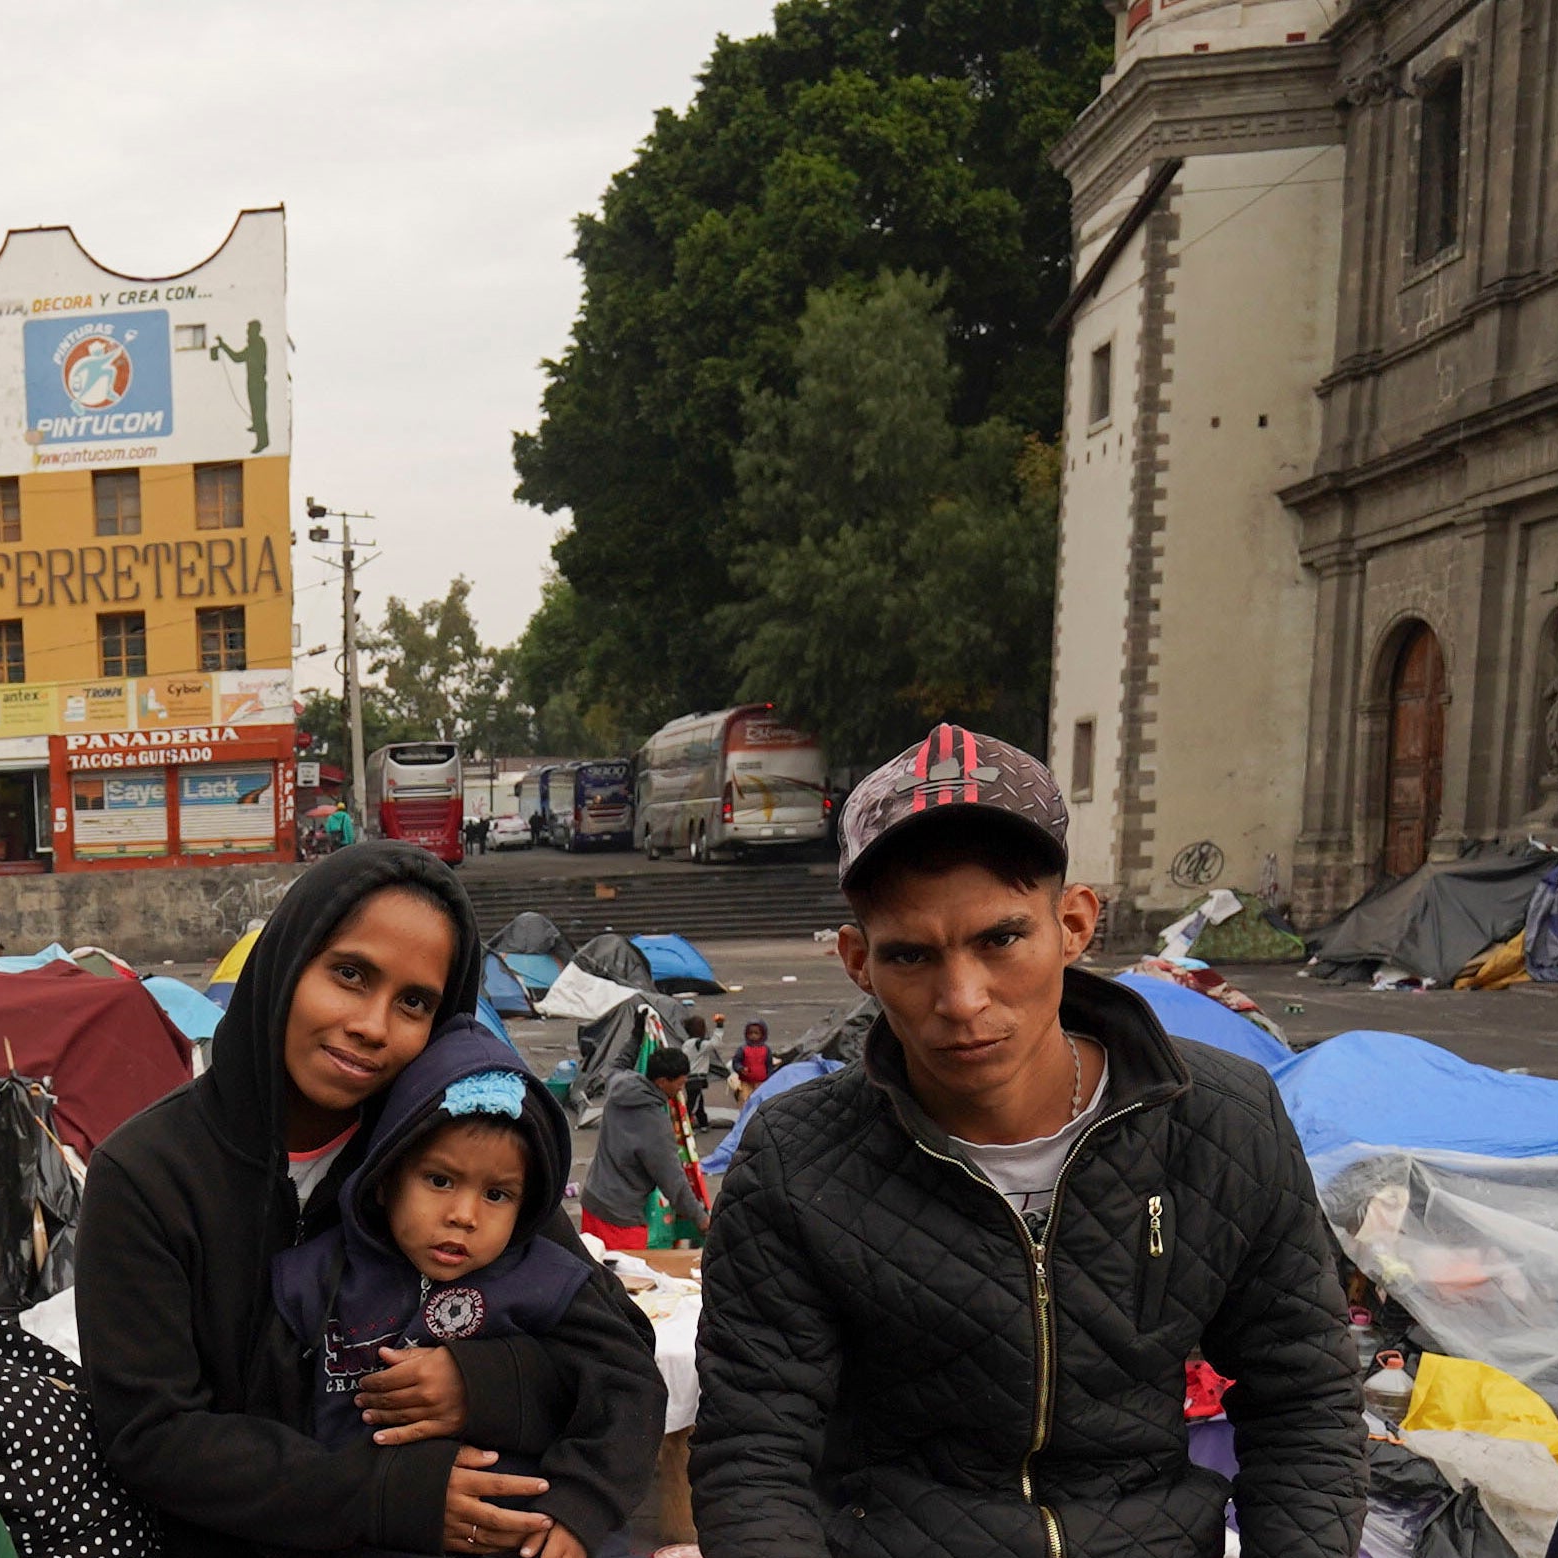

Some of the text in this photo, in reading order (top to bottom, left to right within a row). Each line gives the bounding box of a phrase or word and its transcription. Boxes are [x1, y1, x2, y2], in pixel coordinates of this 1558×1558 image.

[32, 294, 93, 313] DECORA
[99, 293, 111, 307] Y
[117, 290, 160, 306] CREA
[52, 322, 116, 366] PINTURAS
[37, 410, 165, 438] PINTUCOM
[167, 683, 203, 698] Cybor
[65, 727, 240, 751] PANADERIA
[68, 752, 124, 770] TACOS
[138, 746, 213, 765] GUISADO
[183, 776, 240, 799] Lack
[325, 1378, 360, 1393] CHA
